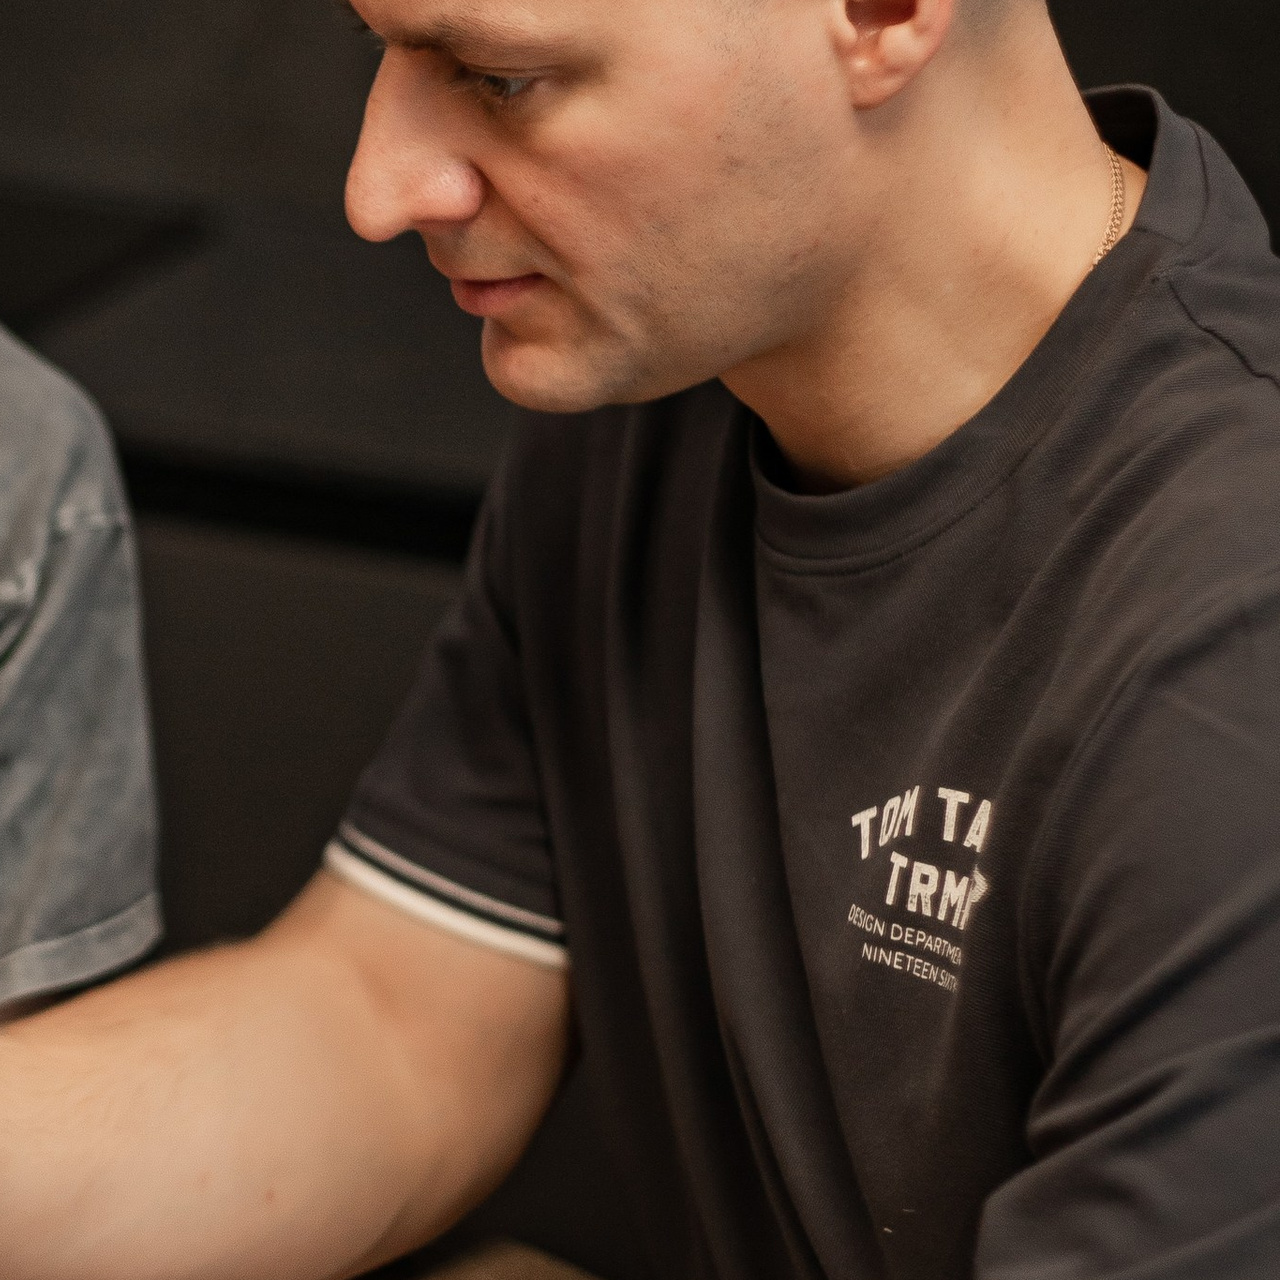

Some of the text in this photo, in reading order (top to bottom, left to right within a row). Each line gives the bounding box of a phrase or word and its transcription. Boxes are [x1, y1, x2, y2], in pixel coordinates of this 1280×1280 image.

[851, 785, 920, 860] TOM
[847, 903, 885, 937] DESIGN
[861, 942, 939, 983] NINETEEN
